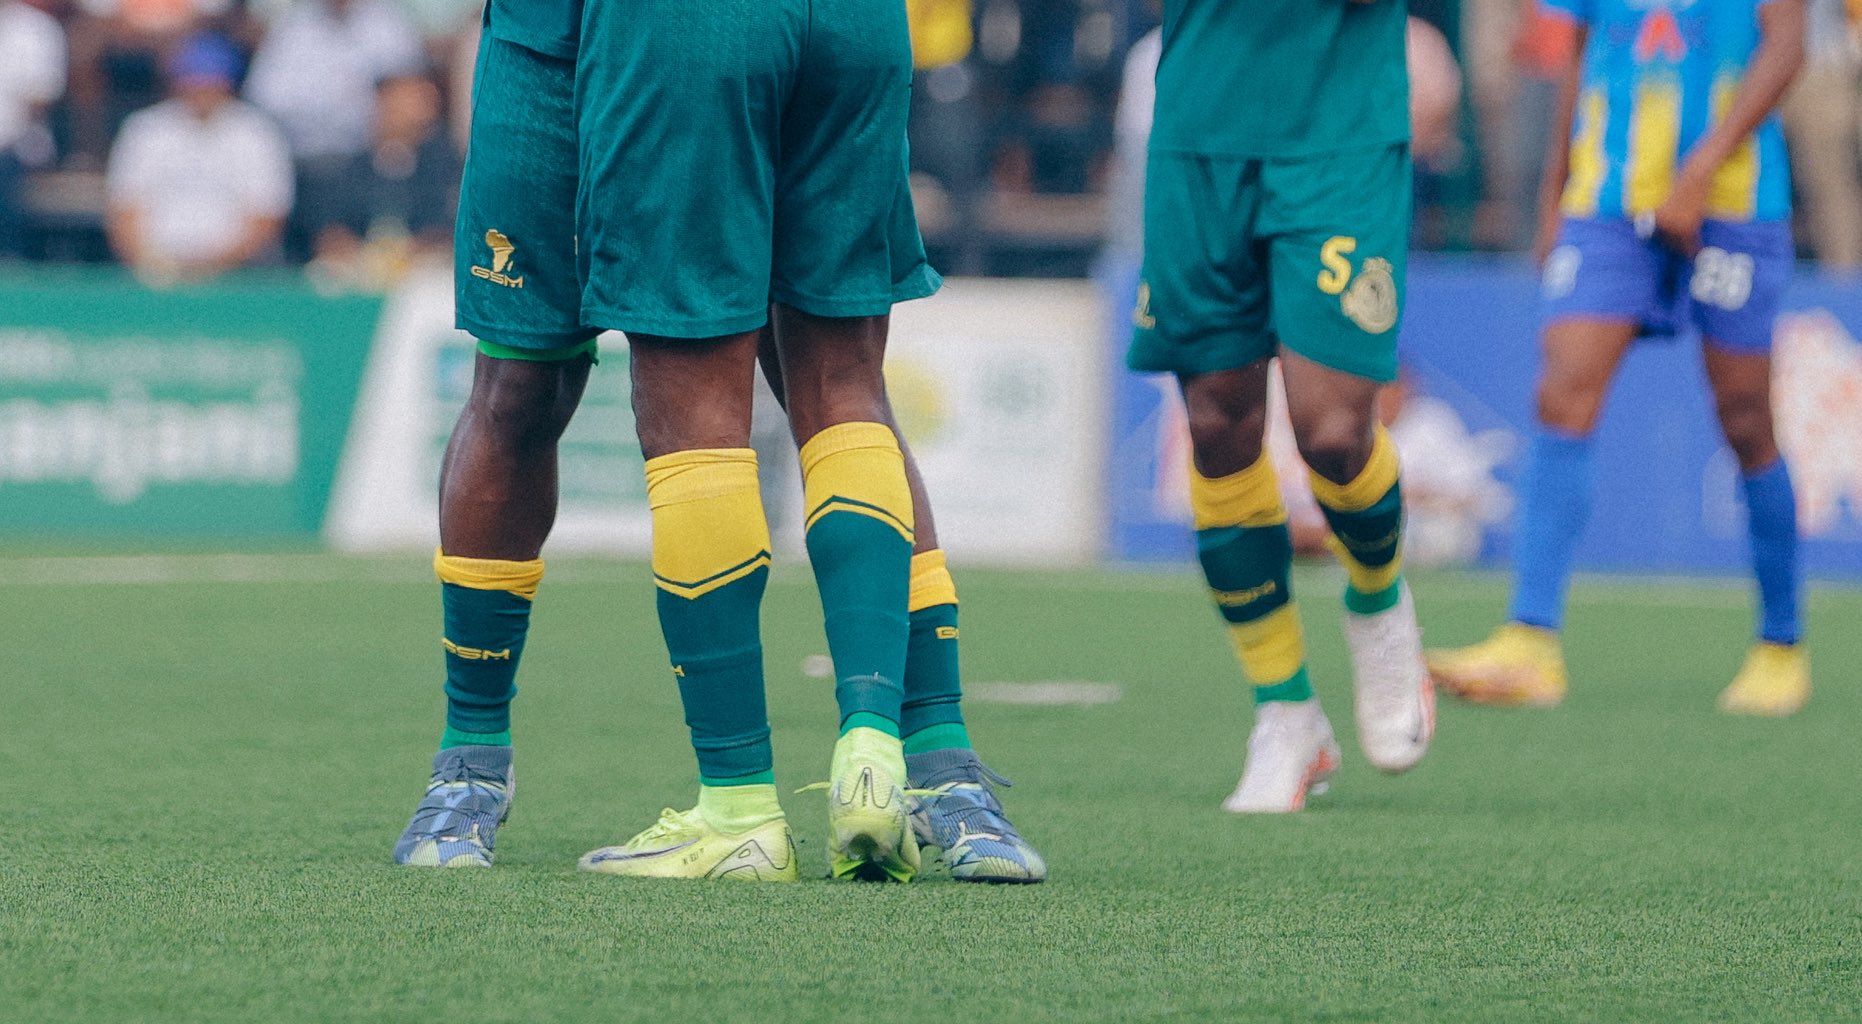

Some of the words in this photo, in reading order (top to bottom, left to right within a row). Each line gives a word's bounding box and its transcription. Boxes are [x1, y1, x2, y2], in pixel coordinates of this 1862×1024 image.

[470, 265, 524, 289] GSM
[1317, 235, 1357, 295] 5
[441, 637, 511, 661] GSM
